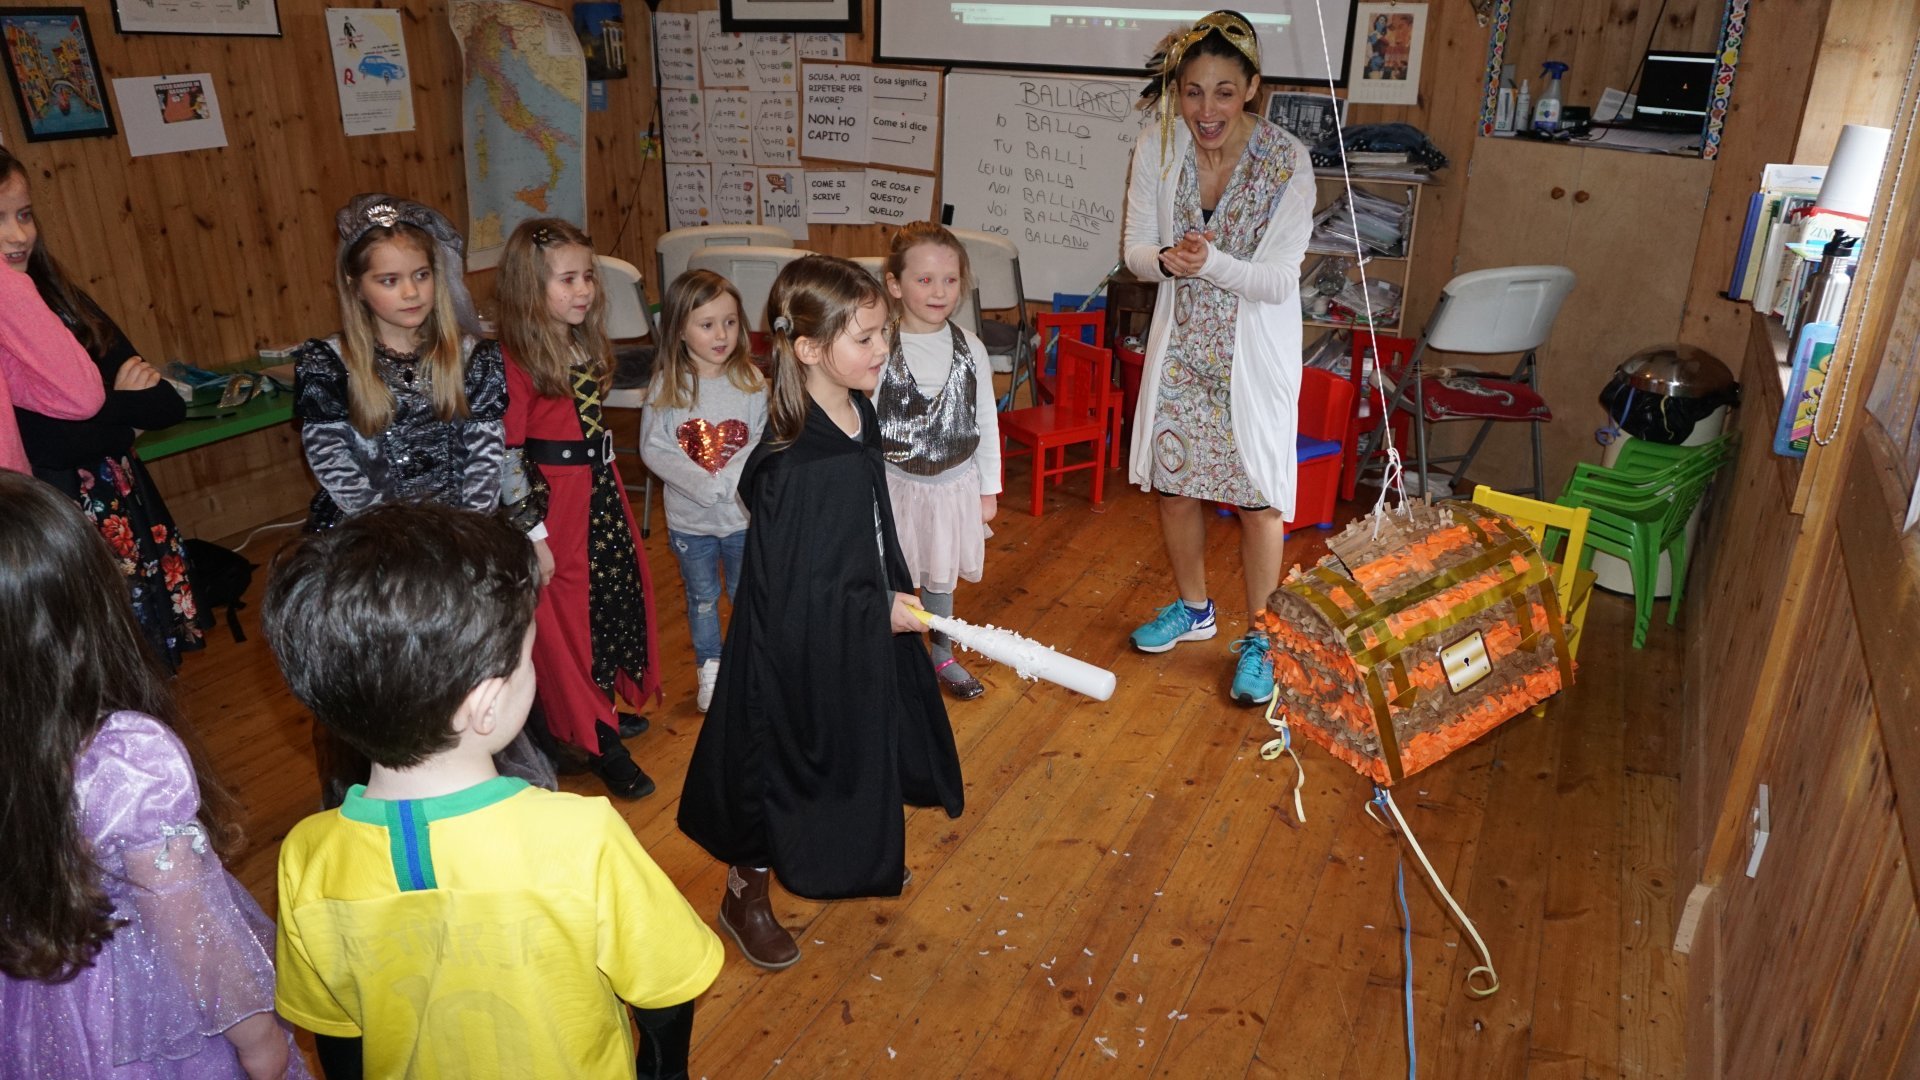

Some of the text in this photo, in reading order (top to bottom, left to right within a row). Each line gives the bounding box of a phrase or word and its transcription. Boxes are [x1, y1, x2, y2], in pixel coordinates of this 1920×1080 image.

[808, 73, 861, 82] SCUSA, PUOI
[873, 75, 927, 87] Cosa significa
[808, 84, 863, 93] RIPETERE PER
[809, 95, 844, 103] FAVORE?
[808, 113, 856, 127] NON HO
[873, 116, 928, 131] Come si dice
[1025, 112, 1090, 134] BALLO
[808, 130, 850, 142] CAPITO
[993, 139, 1013, 154] TU
[1024, 168, 1074, 184] BALLA
[871, 179, 887, 188] CHE
[890, 182, 911, 191] COSA
[764, 198, 800, 222] In piedi
[868, 206, 904, 217] QUELLO?
[1023, 207, 1101, 231] BALLATE
